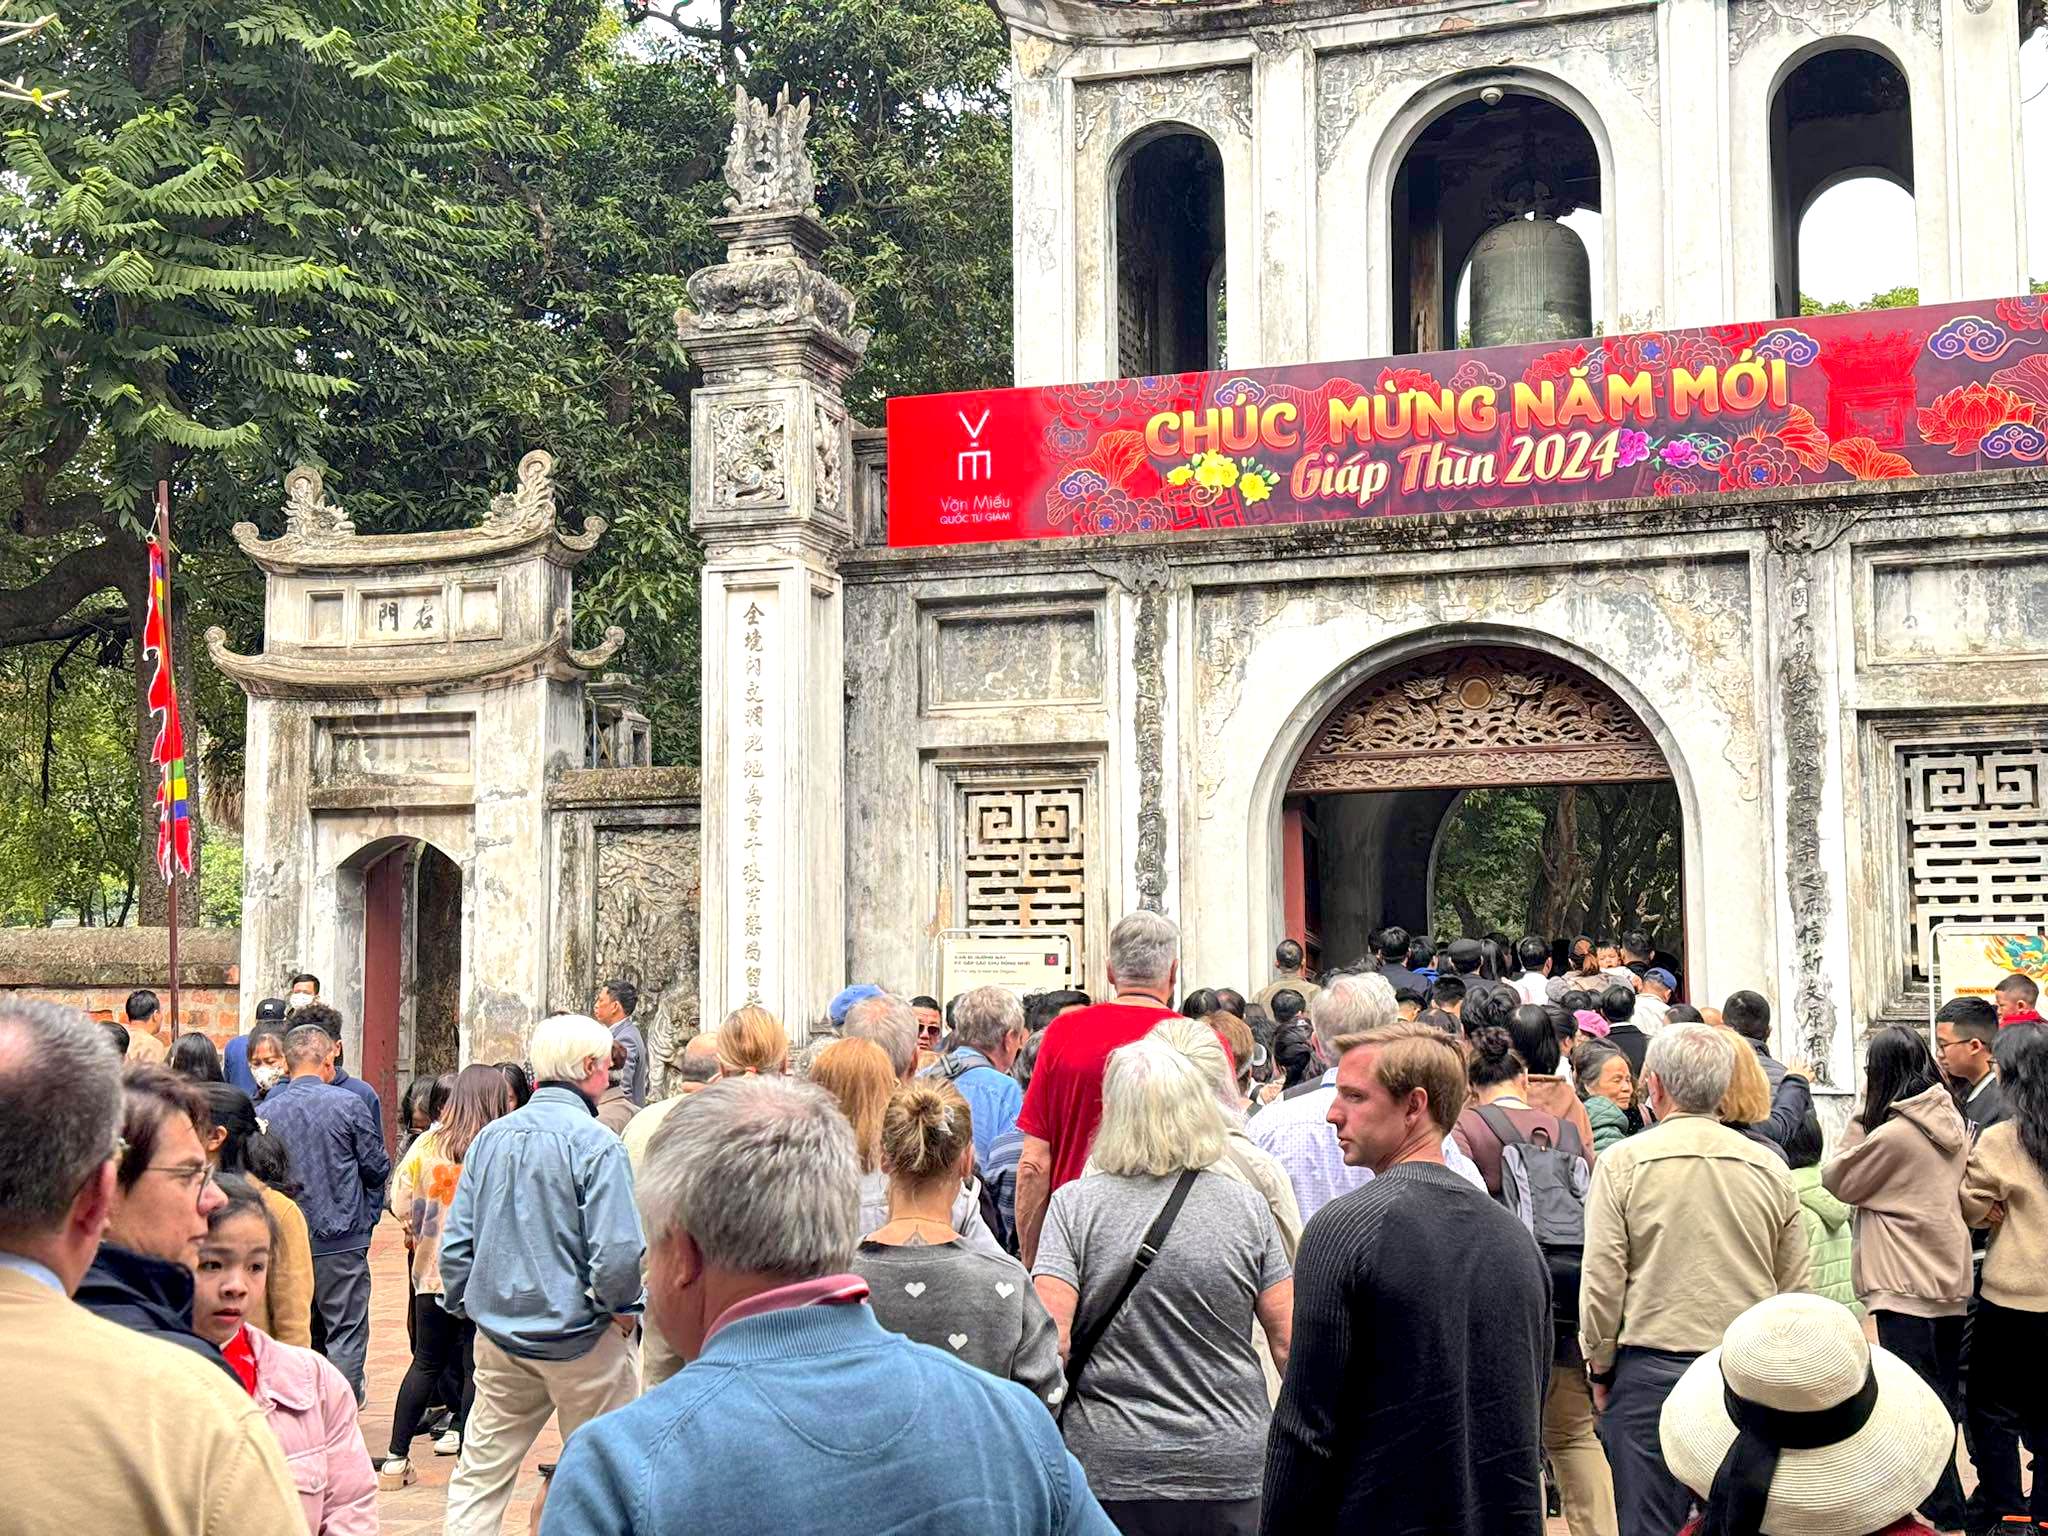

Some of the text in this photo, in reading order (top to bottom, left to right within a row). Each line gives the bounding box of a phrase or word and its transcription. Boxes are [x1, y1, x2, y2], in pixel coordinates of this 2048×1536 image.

[1145, 348, 1788, 457] CHÚC MỪNG NĂM MỚI
[940, 492, 1011, 513] Văn Miếu
[1292, 426, 1622, 506] Giáp Thìn 2024
